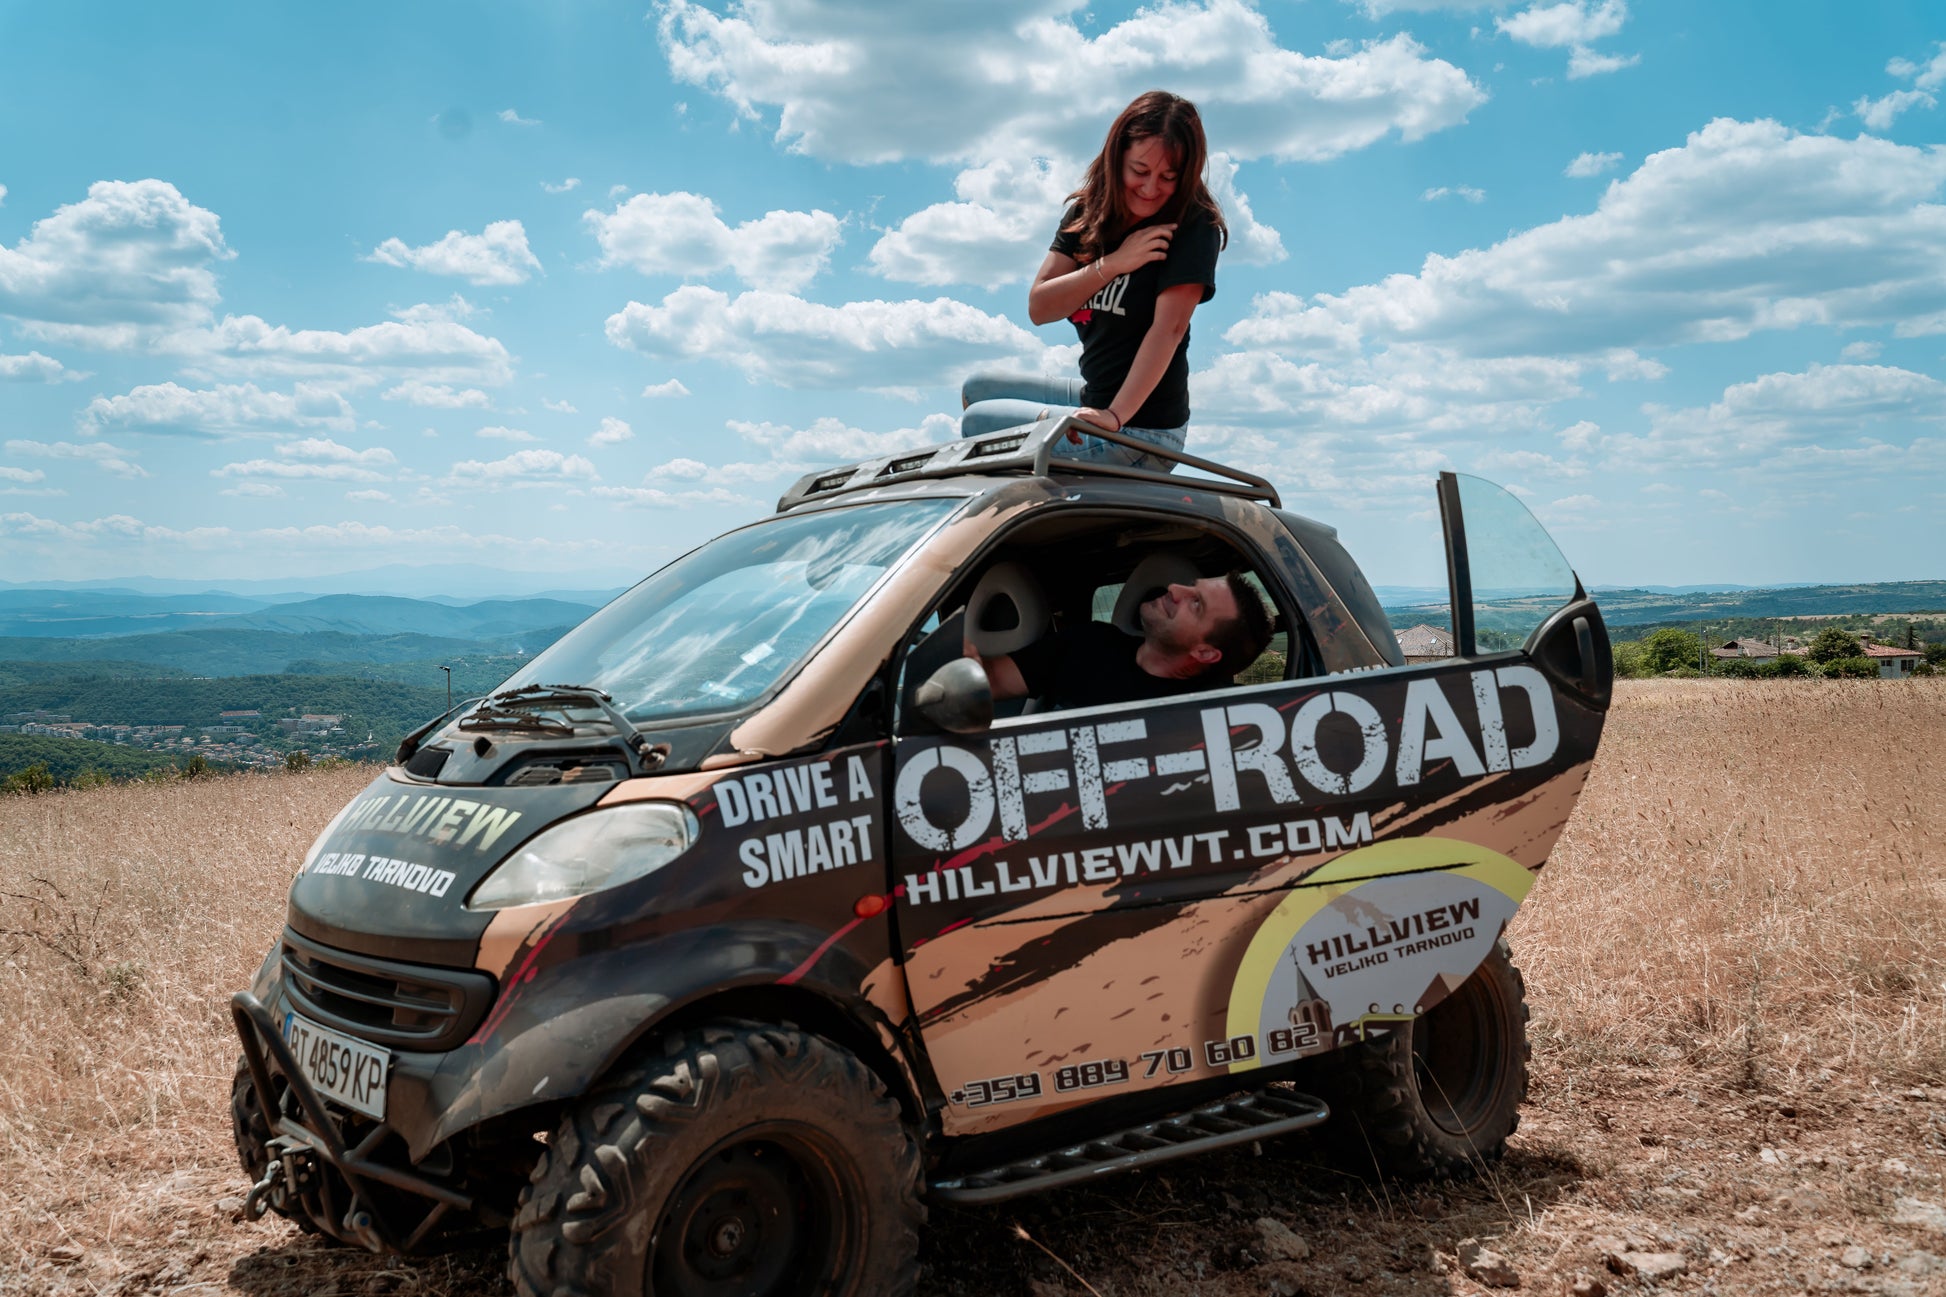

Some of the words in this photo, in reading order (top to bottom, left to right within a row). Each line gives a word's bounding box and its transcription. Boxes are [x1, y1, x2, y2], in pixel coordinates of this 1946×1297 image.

[712, 760, 839, 829] DRIVE
[847, 755, 874, 803] A
[895, 665, 1560, 852] OFF-ROAD
[337, 795, 522, 851] HILLVIEW
[739, 815, 873, 888] SMART
[903, 812, 1374, 905] HILLVIEWVT.COM
[312, 852, 366, 876] VELIKO
[362, 855, 456, 898] TARNOVO
[1306, 898, 1480, 966] HILLVIEW
[1324, 951, 1388, 979] VELIKO
[1393, 927, 1475, 958] TARNOVO
[309, 1036, 351, 1094] 4859
[352, 1052, 382, 1105] KP
[949, 1072, 1042, 1108] +359
[1054, 1057, 1130, 1093] 889
[1142, 1046, 1192, 1079] 70
[1204, 1034, 1256, 1067] 60
[1267, 1022, 1319, 1055] 82
